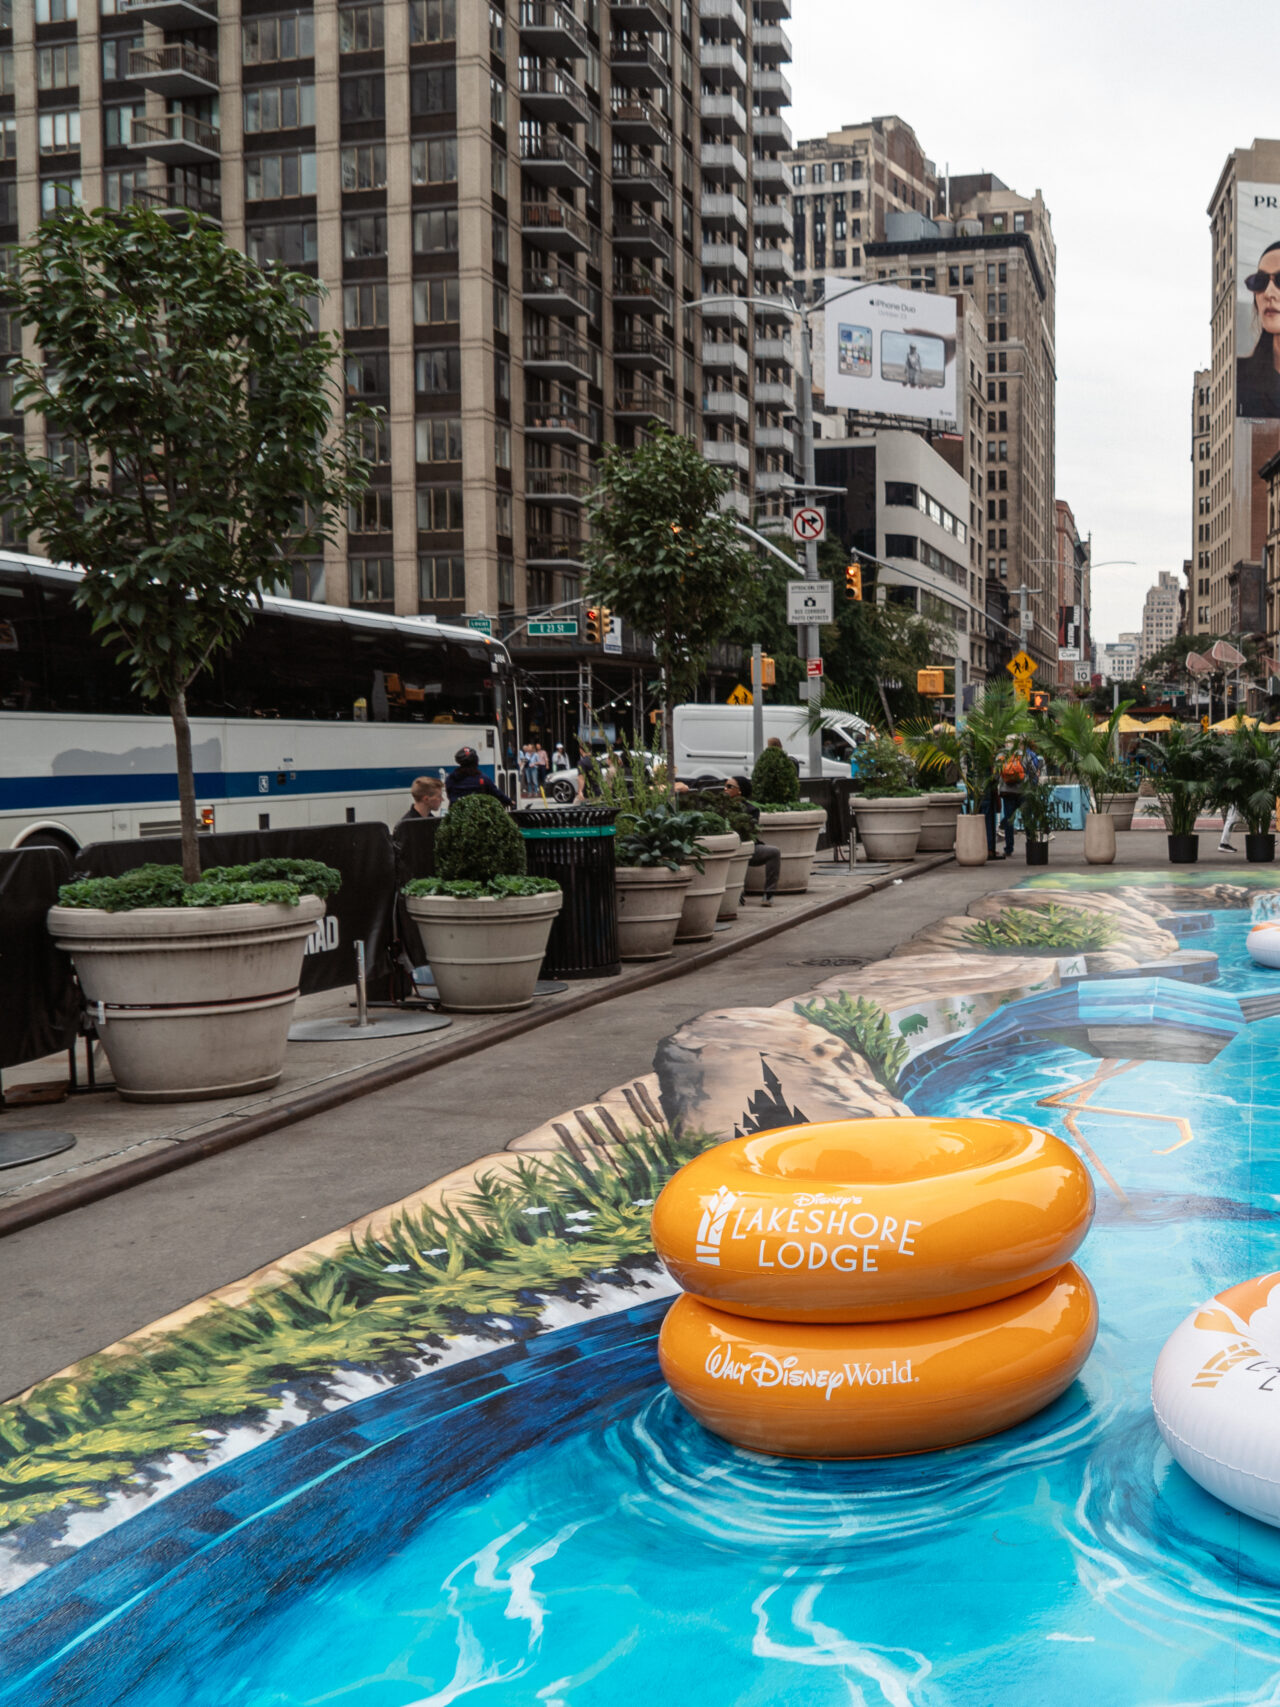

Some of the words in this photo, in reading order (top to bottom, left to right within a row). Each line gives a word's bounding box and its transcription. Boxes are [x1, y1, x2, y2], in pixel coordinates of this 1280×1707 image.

[876, 299, 900, 311] iPhone
[901, 303, 916, 314] Duo
[547, 624, 555, 633] 23
[557, 624, 564, 632] St
[1077, 672, 1088, 680] 10
[1063, 801, 1073, 813] IN
[792, 1192, 864, 1209] Disney's
[731, 1207, 922, 1256] LAKESHORE
[758, 1240, 879, 1272] LODGE
[705, 1343, 752, 1385] Walt
[750, 1351, 844, 1401] Disney
